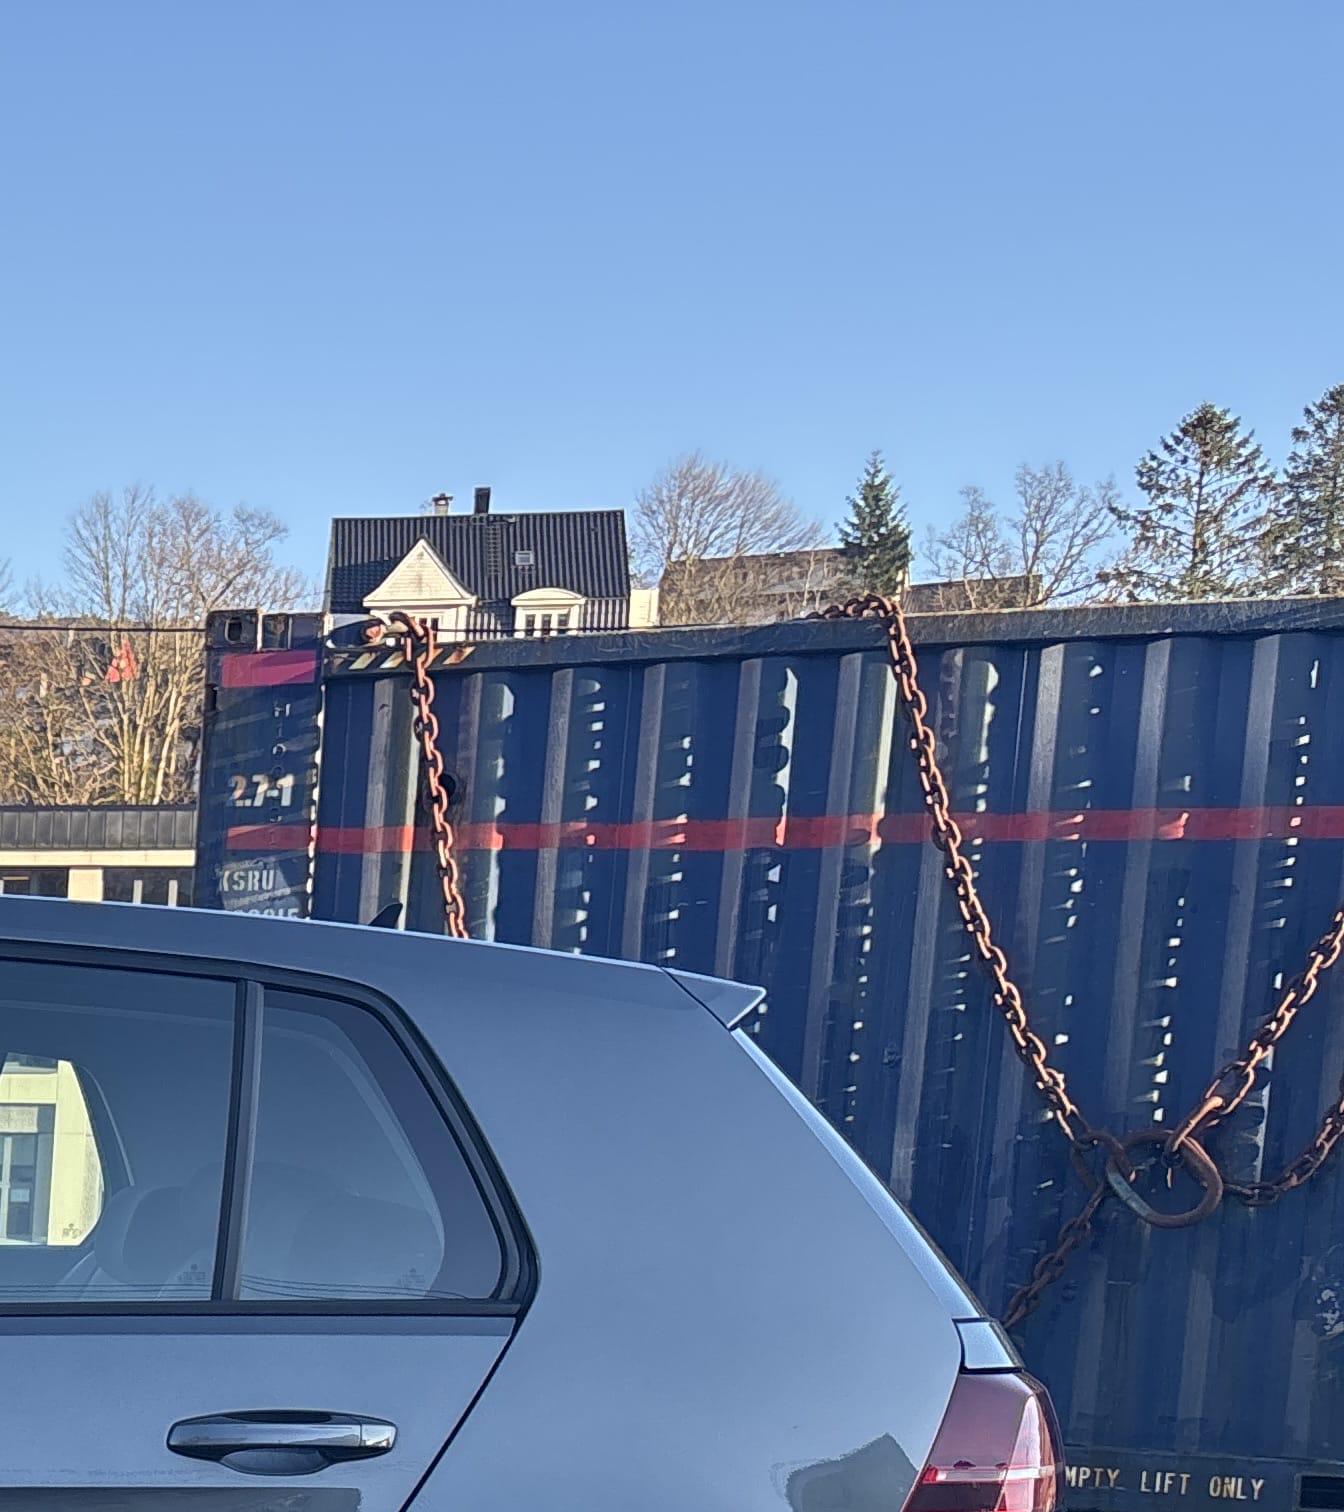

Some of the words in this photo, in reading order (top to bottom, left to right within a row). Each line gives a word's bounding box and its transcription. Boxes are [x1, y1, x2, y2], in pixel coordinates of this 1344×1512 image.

[1064, 1465, 1121, 1488] MPTY
[1140, 1470, 1192, 1496] LIFT
[1209, 1475, 1265, 1501] ONLY
